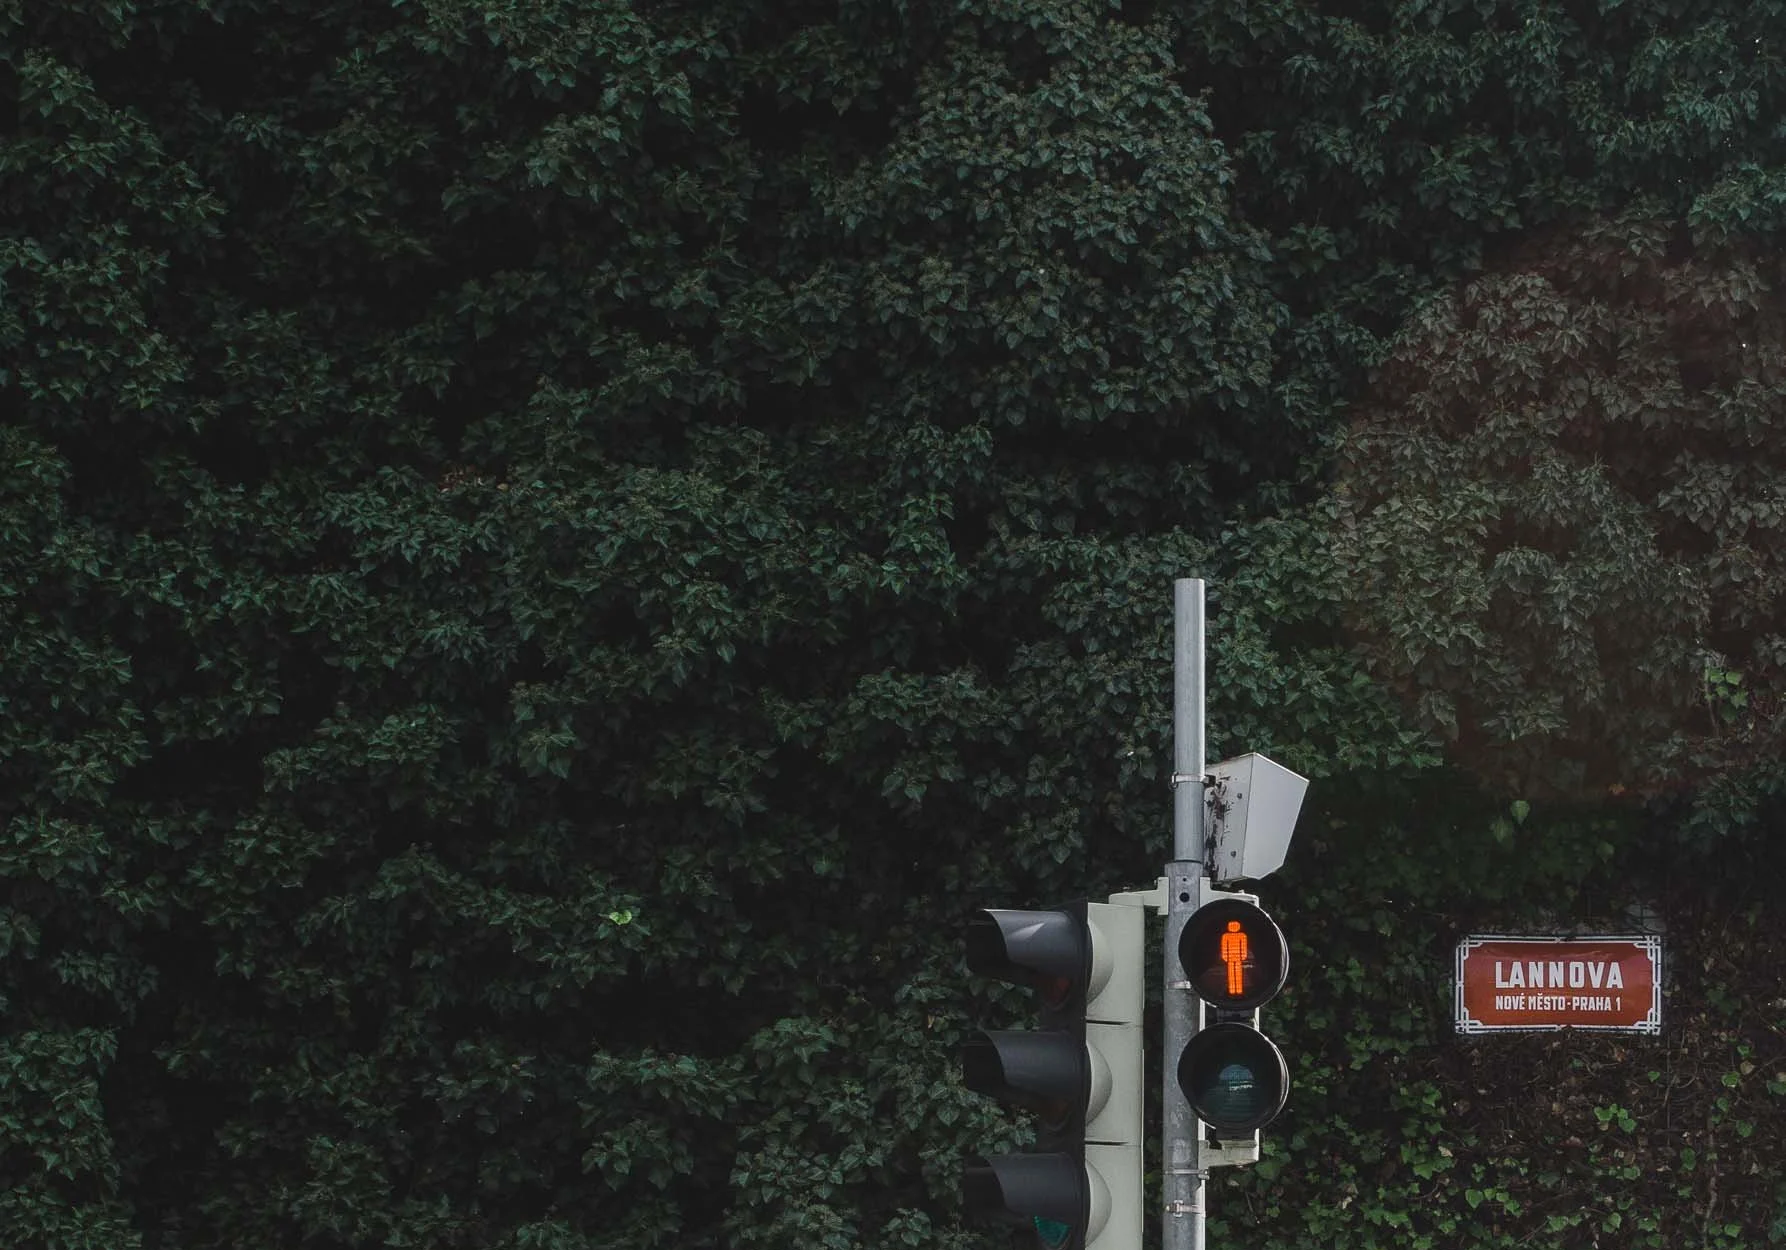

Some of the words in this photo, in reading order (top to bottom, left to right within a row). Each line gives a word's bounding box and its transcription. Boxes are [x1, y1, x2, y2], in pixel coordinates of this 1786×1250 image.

[1495, 961, 1623, 989] LANNOVA
[1495, 993, 1525, 1010] NOVÉ
[1528, 993, 1566, 1011] MĚSTO
[1572, 997, 1612, 1011] PRAHA
[1615, 997, 1621, 1011] 1
